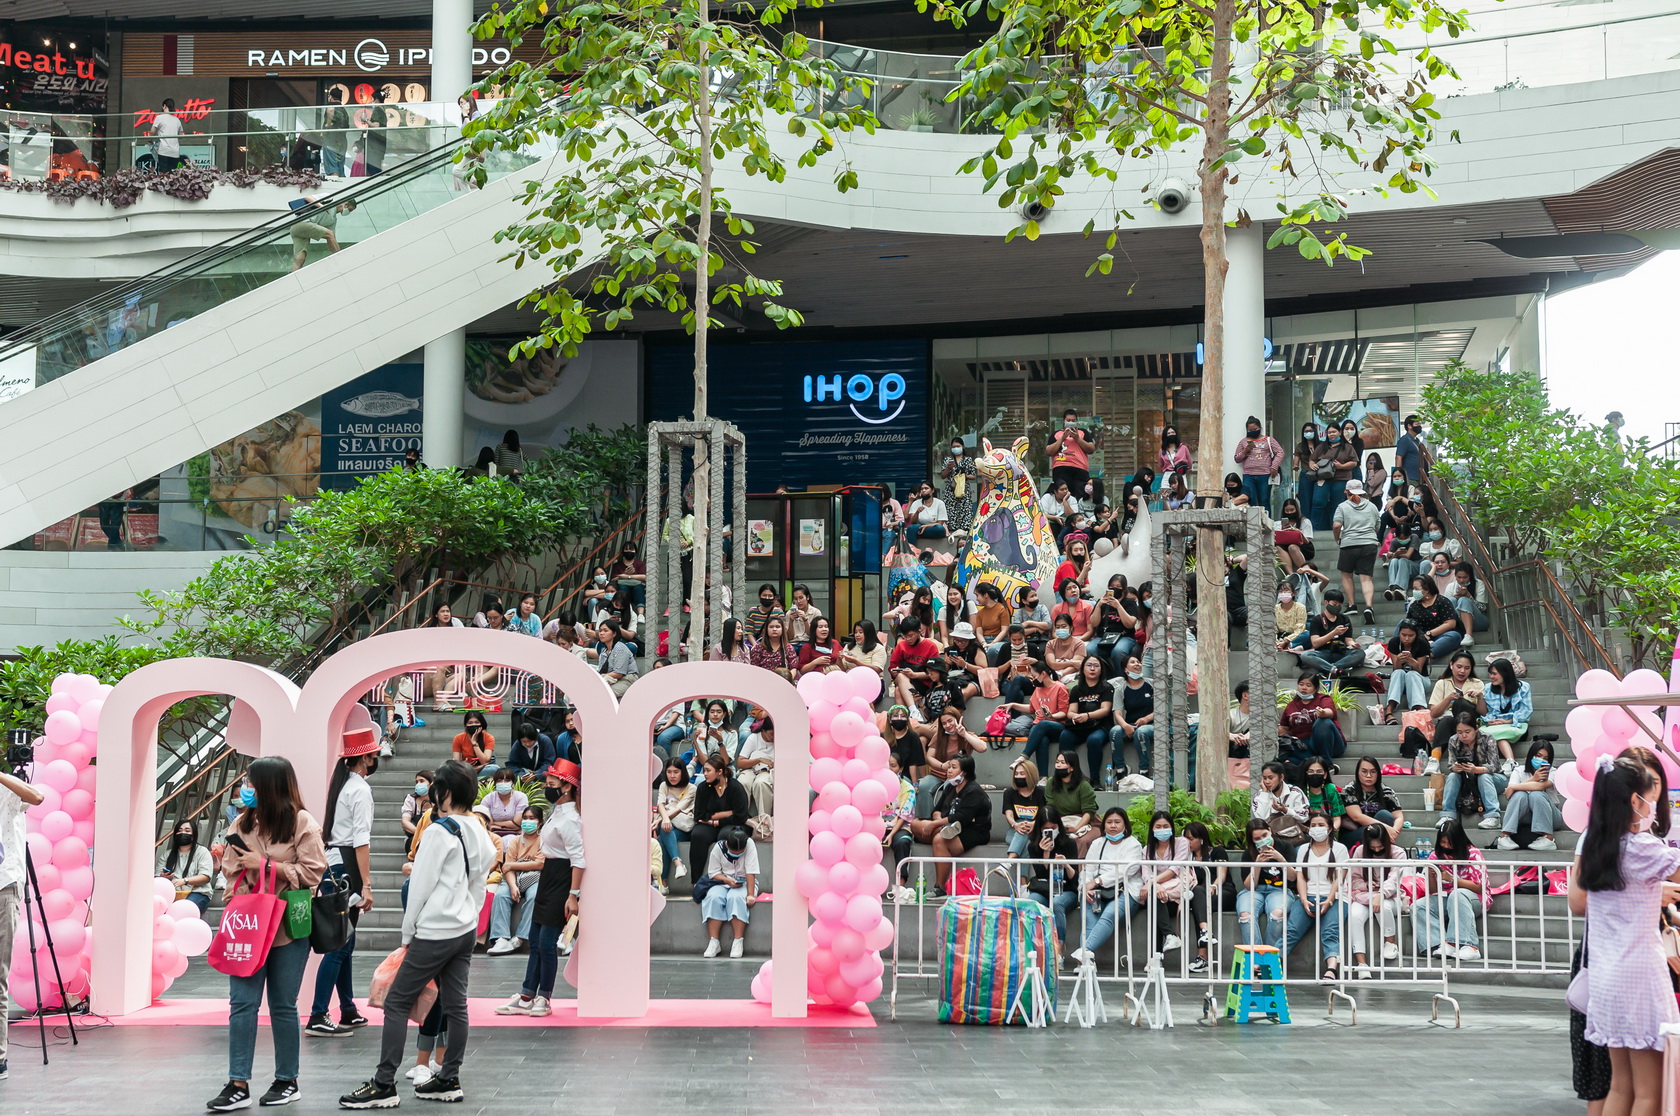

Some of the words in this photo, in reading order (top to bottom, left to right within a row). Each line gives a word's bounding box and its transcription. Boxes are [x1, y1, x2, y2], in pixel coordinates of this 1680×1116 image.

[248, 50, 346, 66] RAMEN
[399, 48, 511, 65] IPDO
[76, 60, 95, 80] u
[804, 373, 905, 411] IHOP
[339, 424, 373, 434] LAEM
[378, 423, 423, 433] CHARO
[799, 433, 853, 447] Spreading
[854, 431, 908, 445] Happiness
